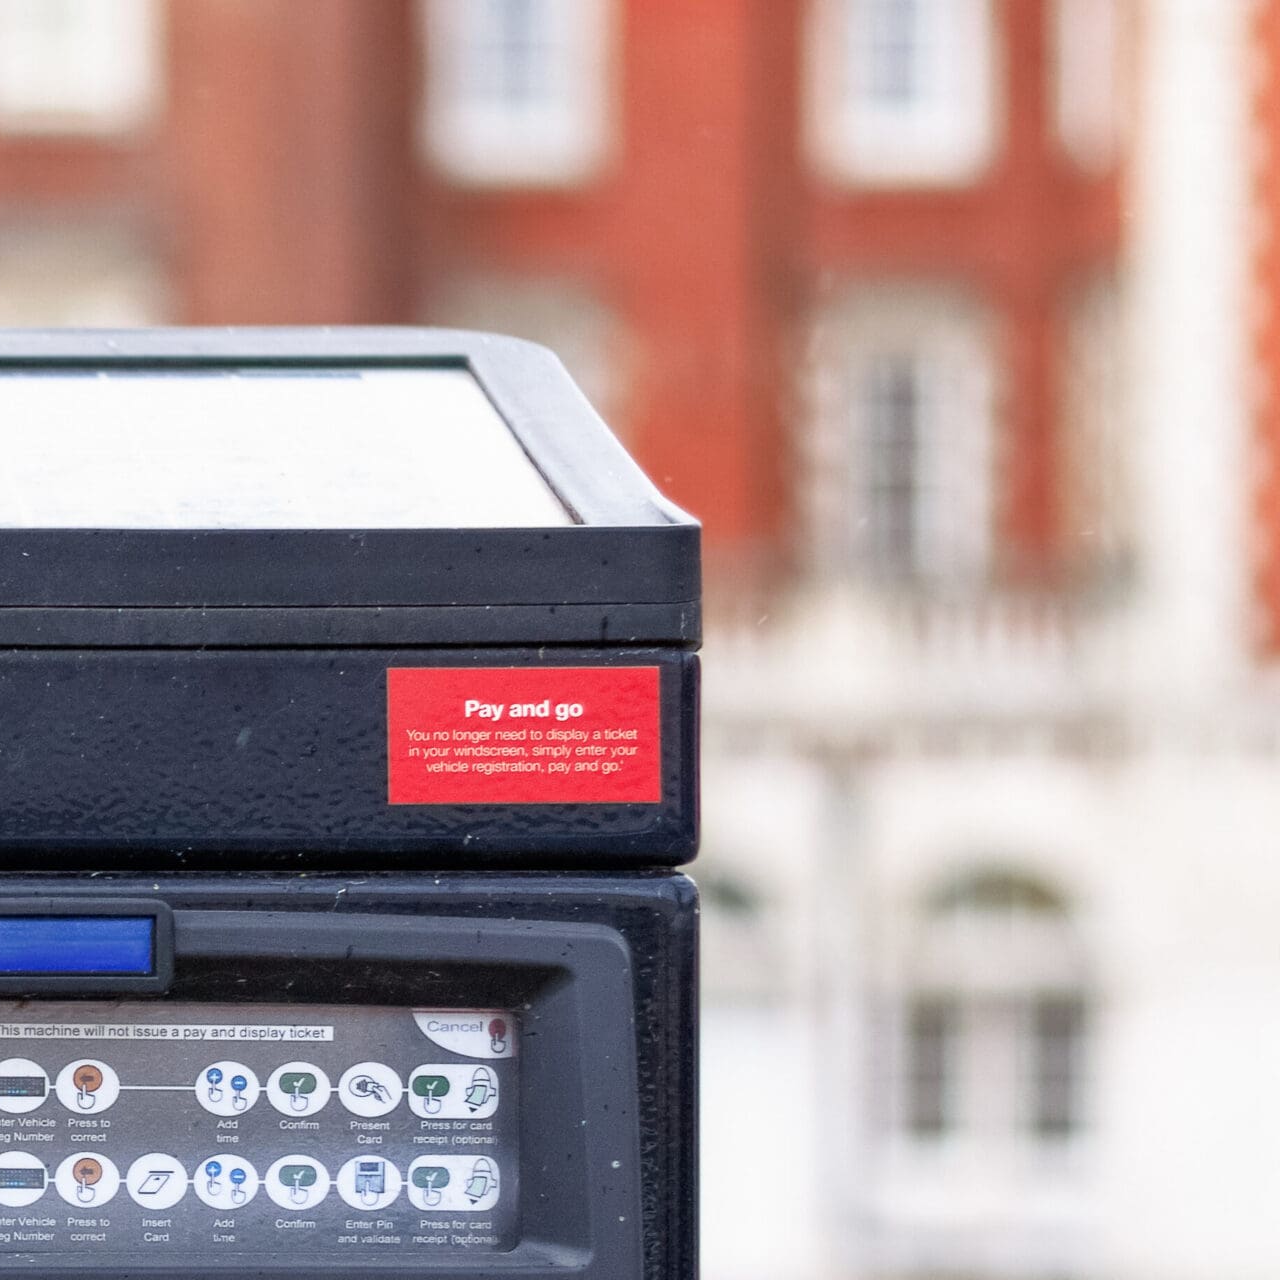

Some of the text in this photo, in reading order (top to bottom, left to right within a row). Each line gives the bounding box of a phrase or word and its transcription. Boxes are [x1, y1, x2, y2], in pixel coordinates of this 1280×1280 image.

[465, 700, 583, 721] Pay and go
[406, 728, 638, 743] You no longer need to display a ticket
[409, 745, 638, 759] in your windscreen, simply enter your
[426, 761, 469, 772] vehicle
[472, 761, 544, 775] registration,
[548, 762, 571, 774] pay
[574, 760, 599, 771] and
[426, 1021, 484, 1033] Cancel
[23, 1024, 81, 1036] machine
[83, 1024, 106, 1036] will
[108, 1025, 130, 1036] not
[132, 1025, 168, 1036] issue
[172, 1029, 179, 1037] a
[182, 1028, 207, 1040] pay
[211, 1028, 236, 1039] and
[240, 1027, 286, 1040] display
[289, 1028, 324, 1039] ticket
[18, 1118, 56, 1127] Vehicle
[68, 1119, 110, 1127] Press to
[217, 1120, 238, 1128] Add
[279, 1120, 319, 1129] Confirm
[350, 1121, 390, 1130] Present
[420, 1121, 492, 1130] Press for card
[14, 1132, 54, 1141] Number
[71, 1133, 106, 1141] correct
[217, 1134, 239, 1143] time
[357, 1135, 382, 1144] Card
[413, 1135, 448, 1145] receipt
